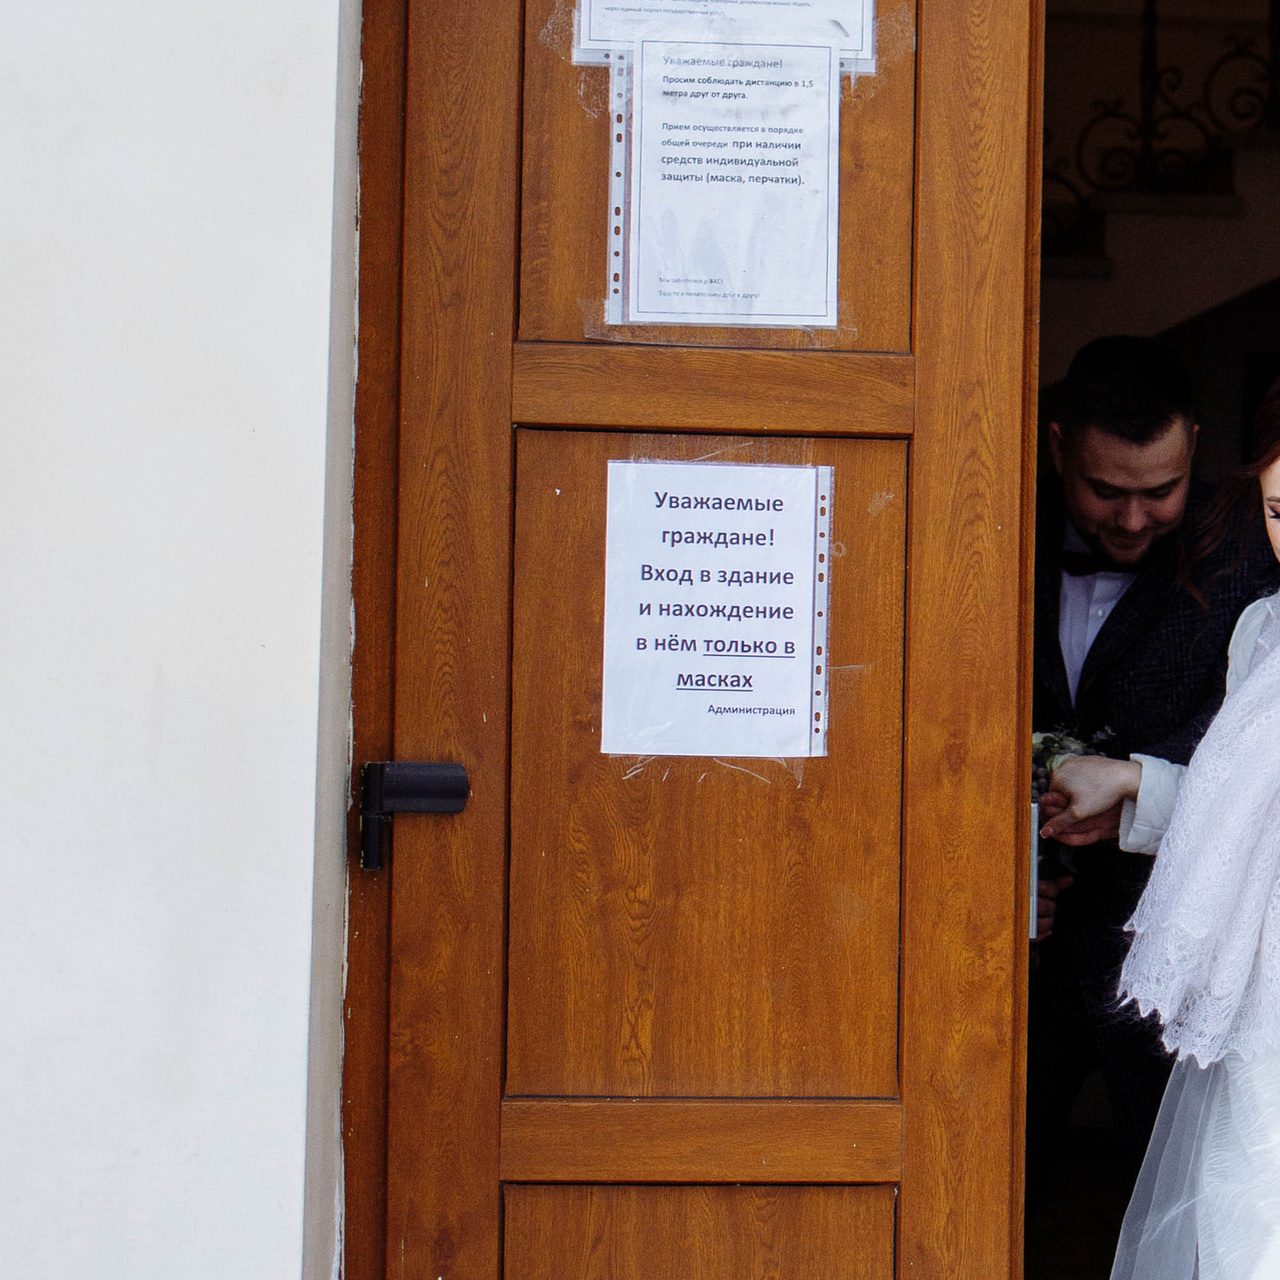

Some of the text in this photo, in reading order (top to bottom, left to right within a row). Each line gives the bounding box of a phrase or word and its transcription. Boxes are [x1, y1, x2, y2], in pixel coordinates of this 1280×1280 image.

[662, 55, 783, 69] Уважаемые граждане!
[662, 75, 696, 84] Просим
[697, 76, 744, 86] соблюдать
[745, 79, 793, 87] дистанцию
[801, 79, 815, 89] 1,5
[662, 90, 689, 98] метра
[690, 91, 710, 99] друг
[722, 92, 749, 100] друга.
[661, 122, 691, 131] Прием
[692, 124, 760, 133] осуществляется
[768, 127, 804, 135] порядке
[661, 138, 802, 150] общей очереди при наличии
[661, 156, 799, 168] средств индивидуальной
[660, 172, 806, 186] защиты (маска, перчатки).
[654, 492, 785, 512] Уважаемые
[661, 529, 776, 548] граждане!
[640, 564, 795, 587] Вход в здание
[638, 602, 795, 621] и нахождение
[636, 633, 795, 655] в нём только в
[676, 673, 753, 689] масках
[707, 705, 796, 716] Администрация
